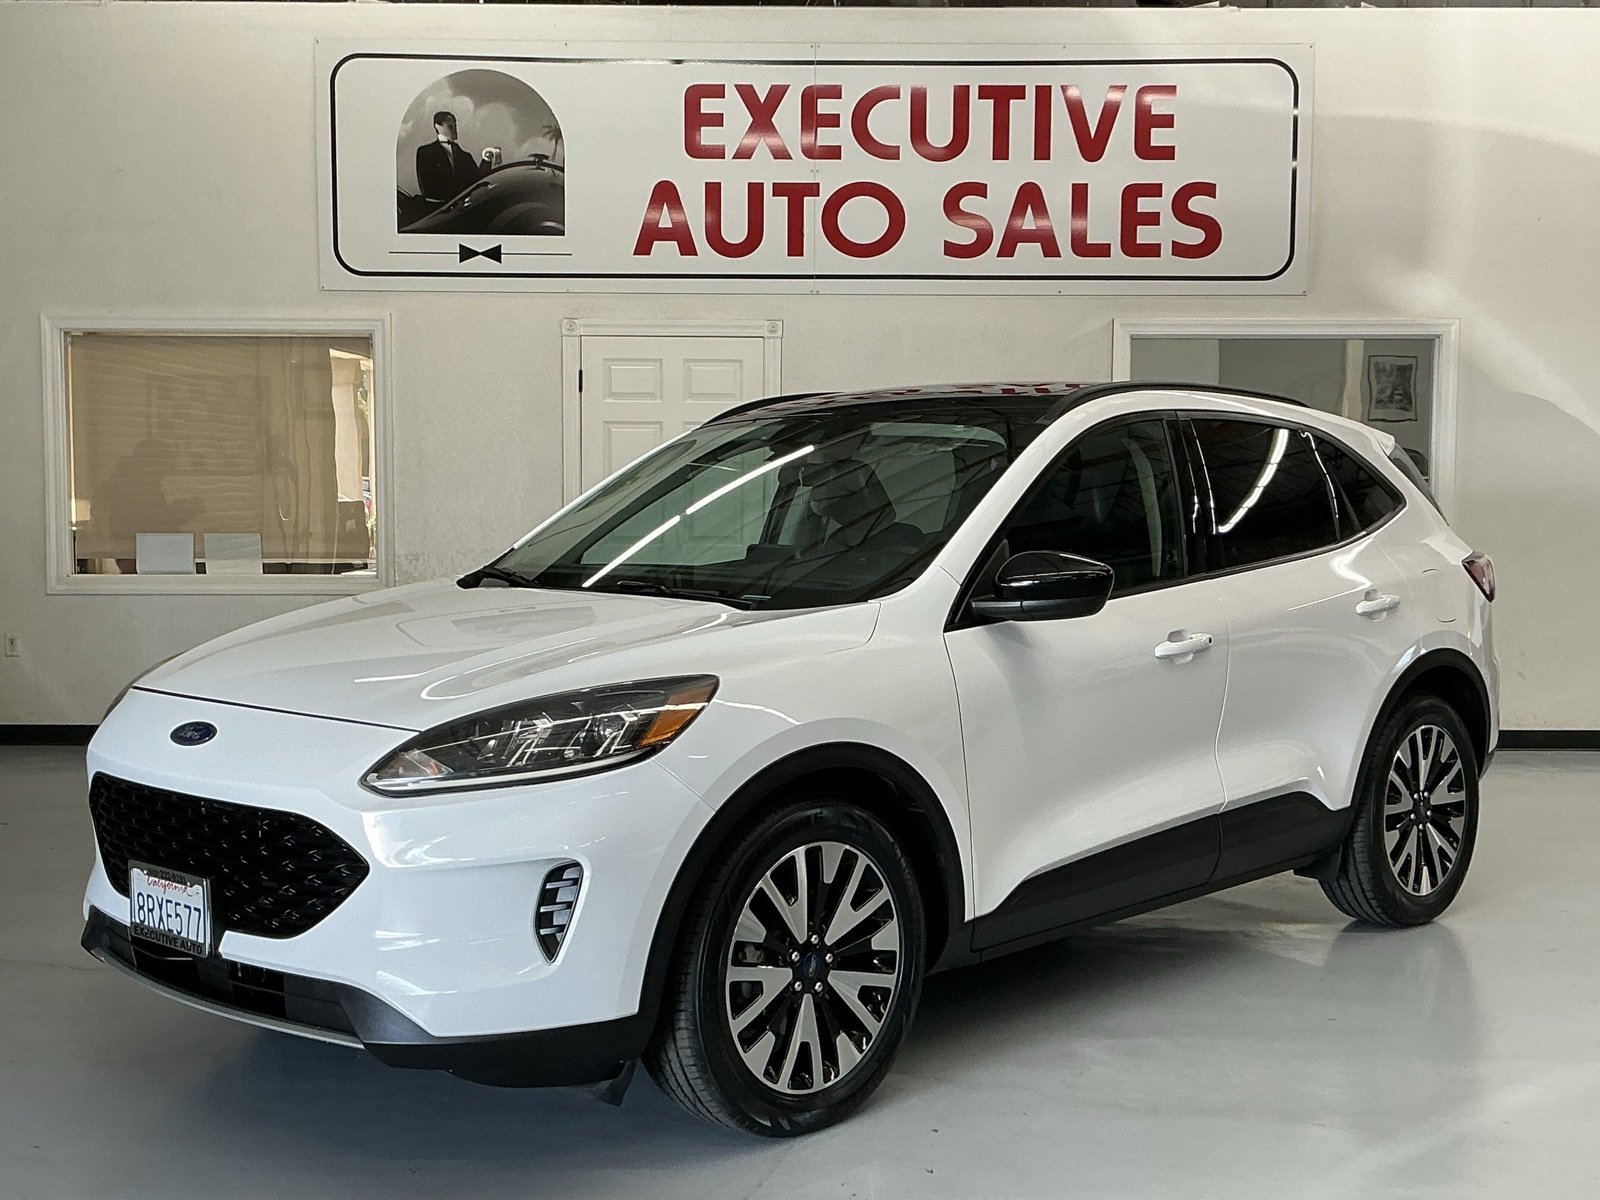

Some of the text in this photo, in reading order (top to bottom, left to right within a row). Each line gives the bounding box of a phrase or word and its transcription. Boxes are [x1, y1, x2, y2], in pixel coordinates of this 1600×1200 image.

[683, 83, 1178, 163] EXECUTIVE
[633, 179, 1223, 260] AUTO SALES
[134, 924, 203, 955] EXECUTIVE AUTO
[137, 891, 202, 942] 8RXE577
